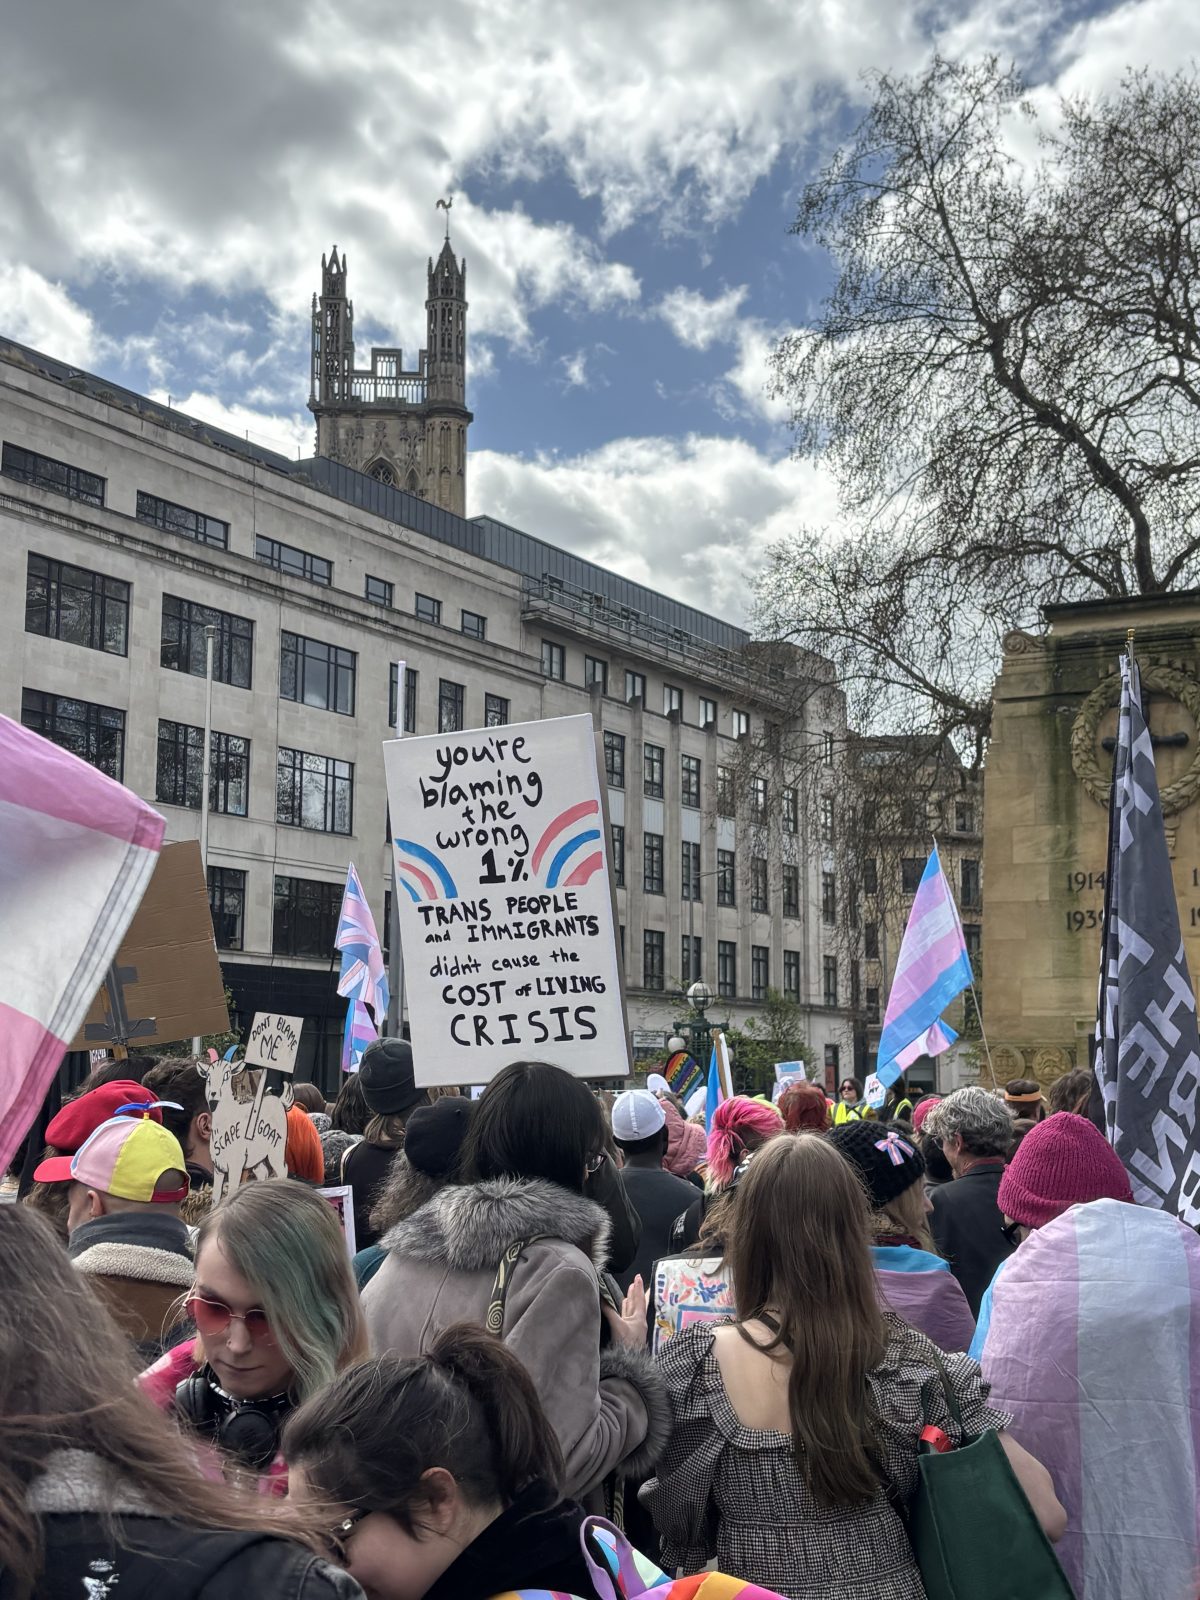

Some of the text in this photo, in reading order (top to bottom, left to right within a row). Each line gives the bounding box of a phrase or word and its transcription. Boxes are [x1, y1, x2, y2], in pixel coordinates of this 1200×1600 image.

[429, 736, 532, 782] you're
[419, 769, 543, 809] blaming
[462, 799, 516, 825] the
[435, 824, 530, 857] wrong
[479, 849, 529, 884] 1%
[418, 892, 578, 927] TRANS PEOPLE
[425, 915, 600, 944] and IMMIGRANTS
[429, 947, 580, 978] didn't cause the
[442, 980, 507, 1007] COST
[536, 975, 606, 996] LIVING
[276, 1016, 298, 1051] BLAME
[450, 1005, 598, 1047] CRISIS
[259, 1034, 283, 1061] ME
[213, 1119, 283, 1156] SCAPE GOAT
